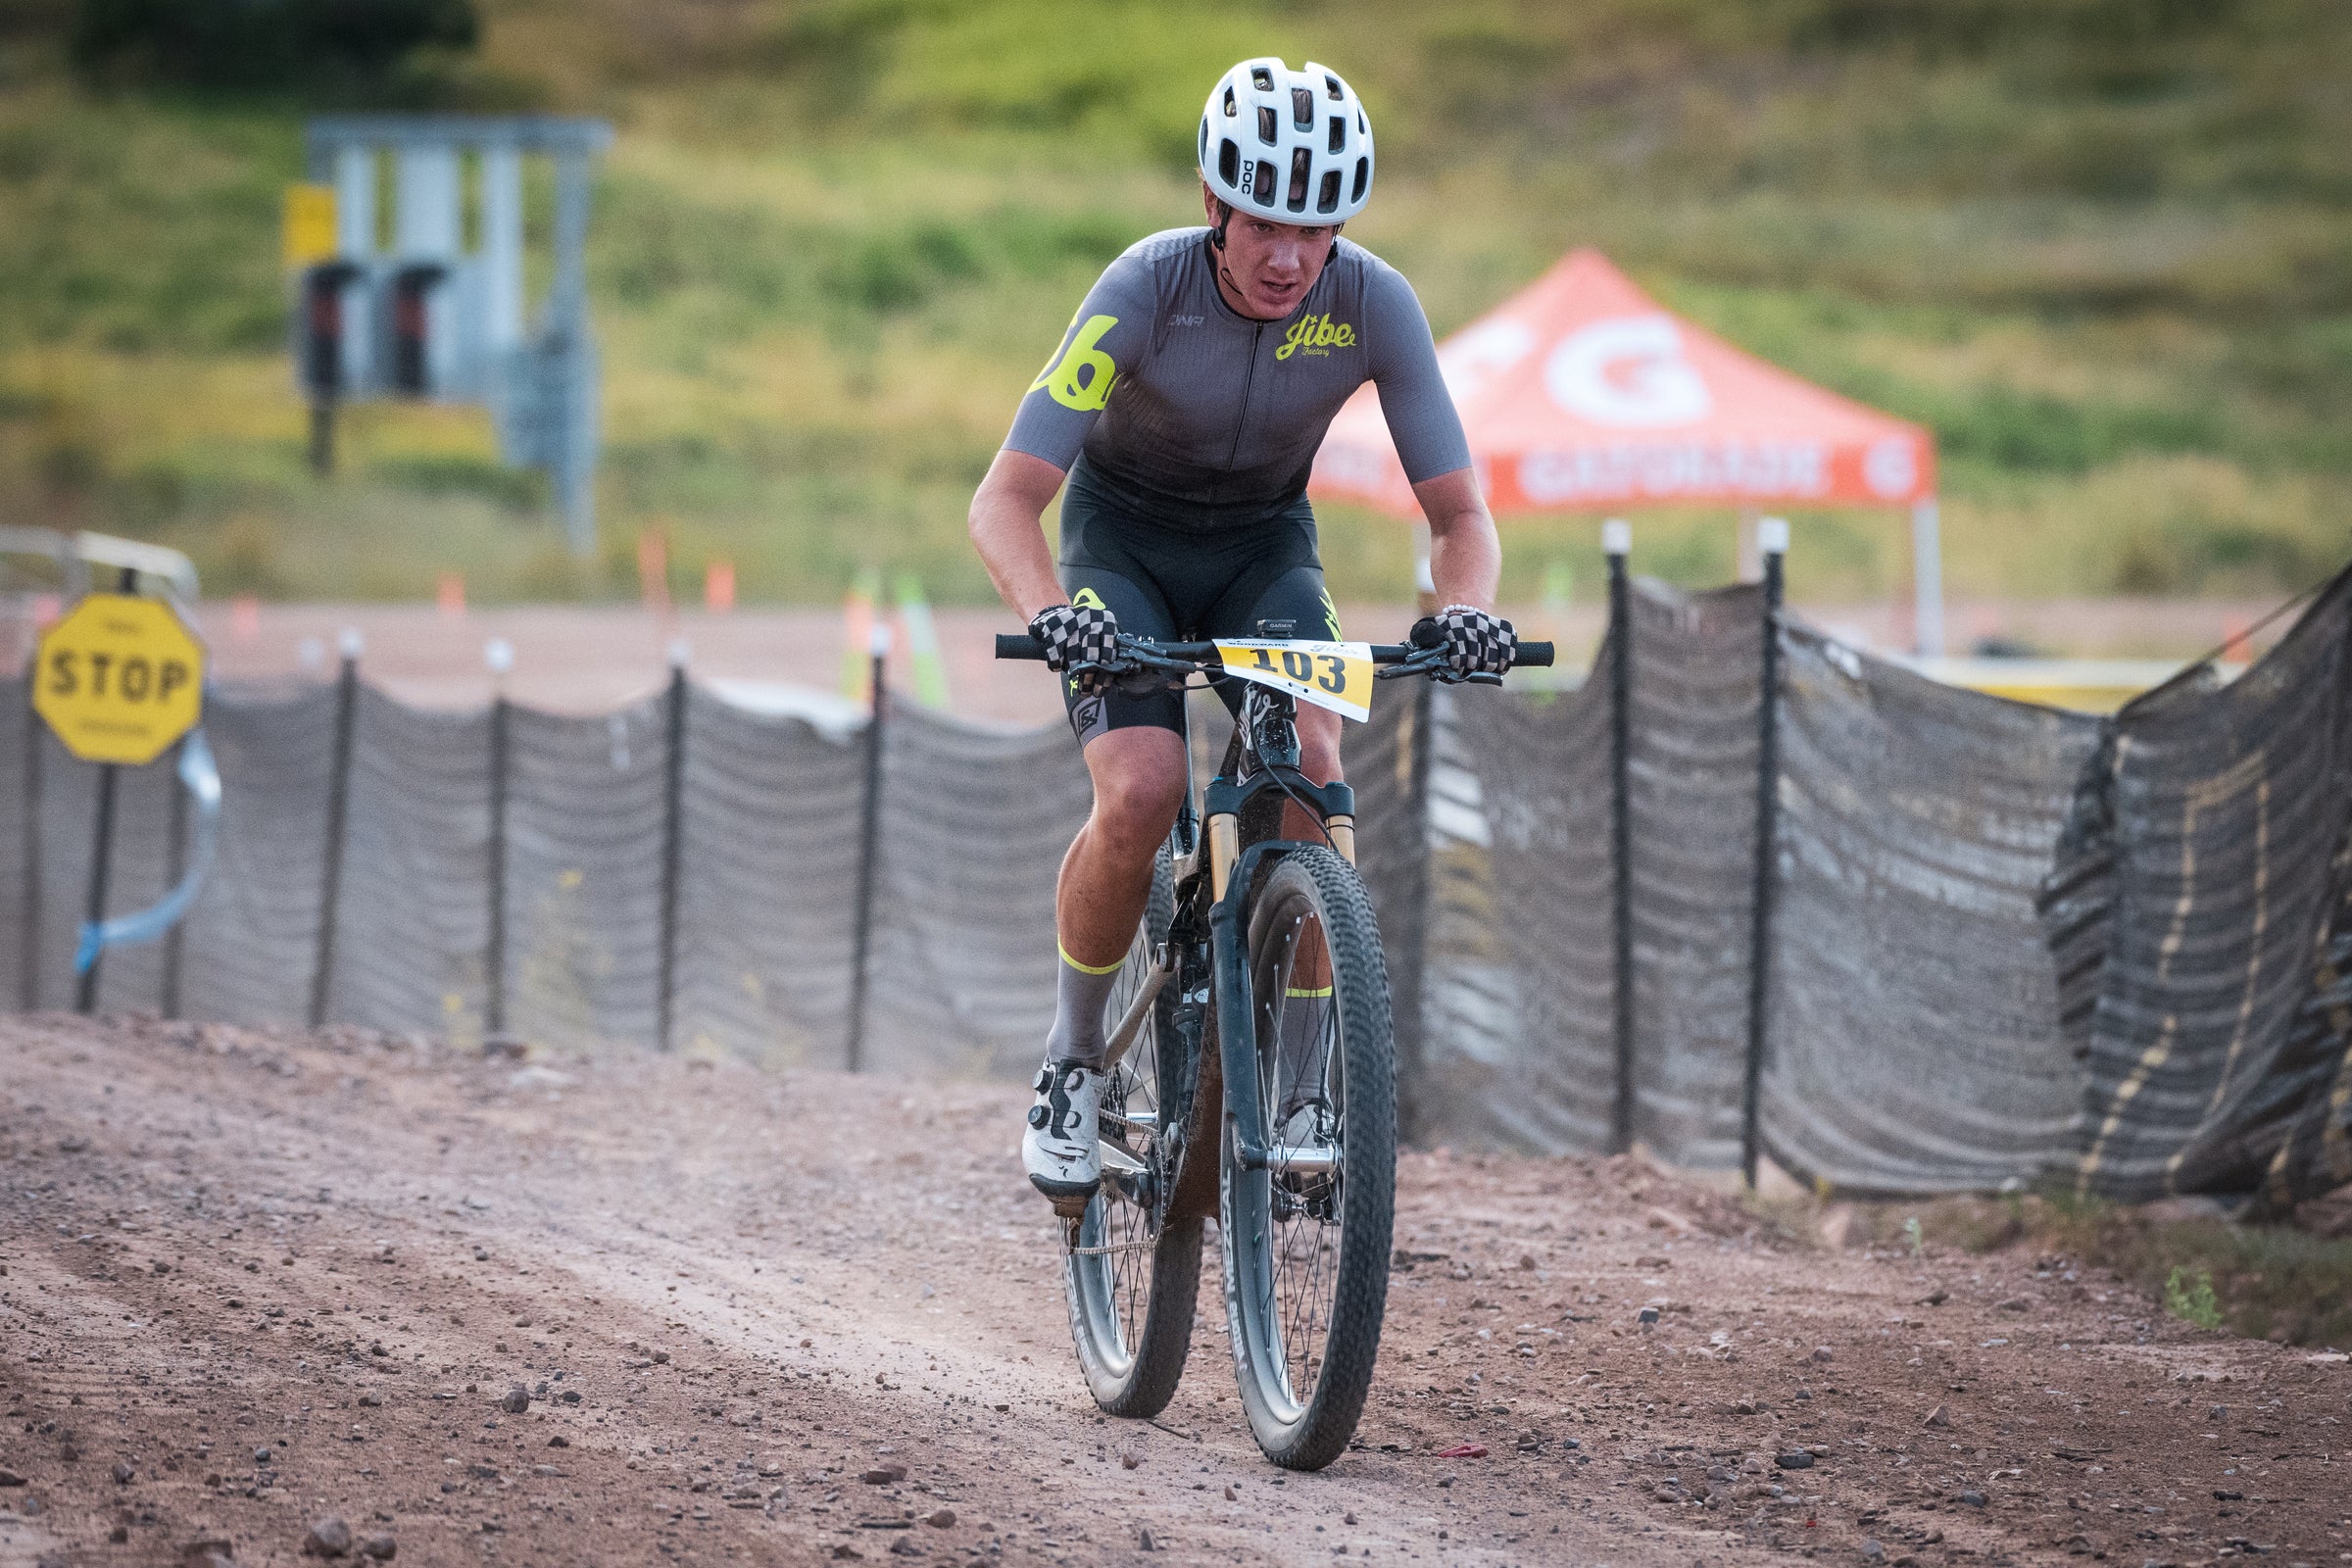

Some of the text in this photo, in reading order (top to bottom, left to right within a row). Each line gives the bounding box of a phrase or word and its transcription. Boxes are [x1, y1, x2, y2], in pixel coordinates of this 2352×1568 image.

[1242, 160, 1254, 195] POC
[1276, 313, 1357, 361] Jibe
[1544, 315, 1709, 427] G
[51, 649, 190, 705] STOP
[1250, 649, 1347, 694] 103
